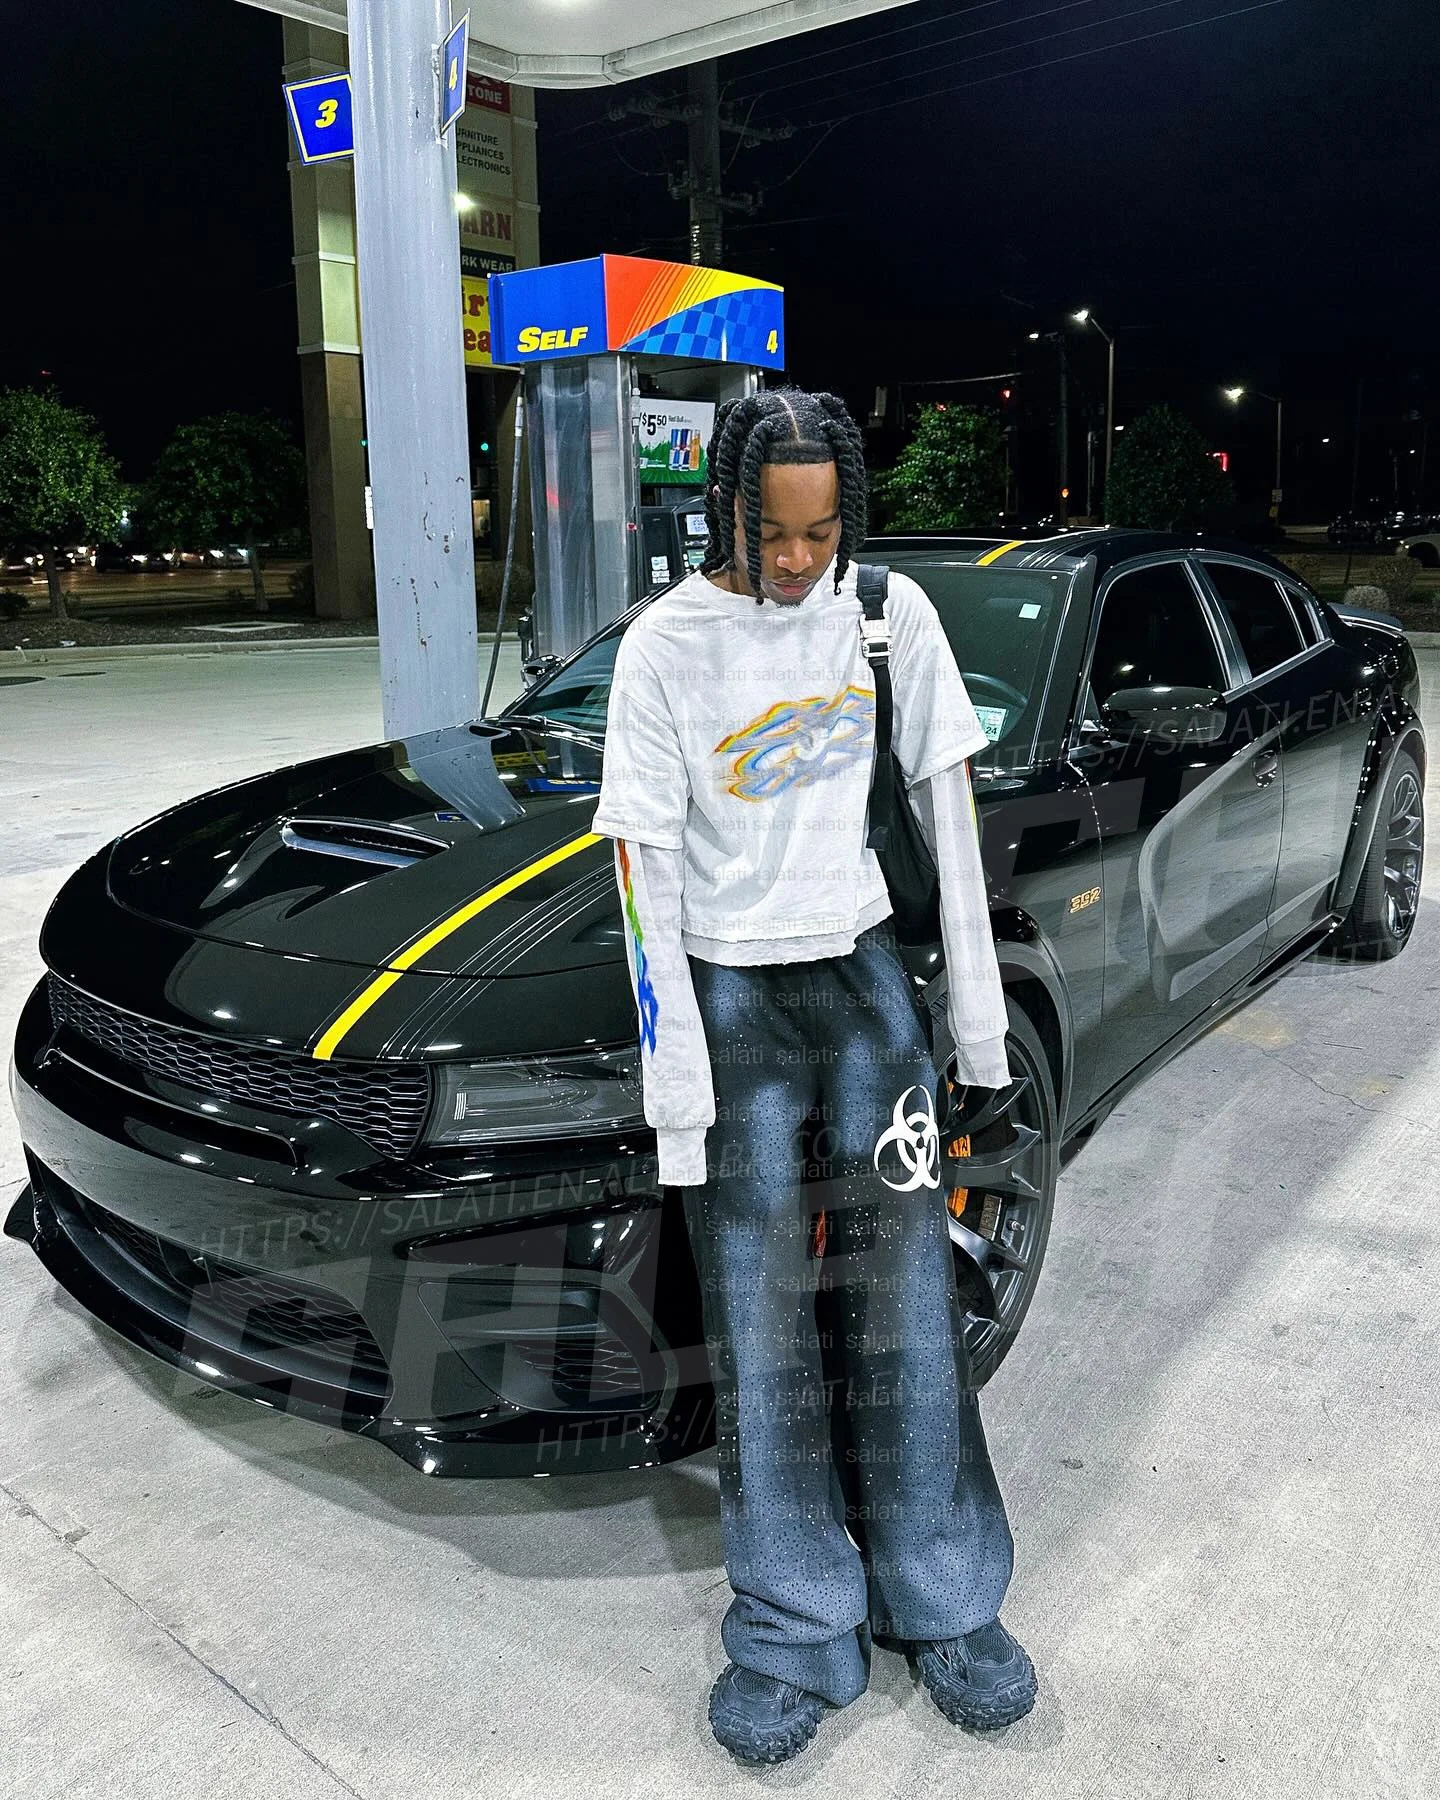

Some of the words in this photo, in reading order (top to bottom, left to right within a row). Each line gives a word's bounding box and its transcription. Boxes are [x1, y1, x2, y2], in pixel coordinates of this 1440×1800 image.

[448, 56, 458, 91] 4
[466, 83, 503, 104] TONE
[315, 99, 338, 129] 3
[457, 128, 500, 146] URNITURE
[456, 140, 504, 160] PPLIANCES
[457, 153, 511, 176] LECTRONICS
[462, 209, 512, 241] ARN
[461, 255, 478, 269] RK
[479, 259, 513, 273] WEAR
[463, 327, 491, 353] ea
[517, 326, 589, 354] SELF
[766, 329, 778, 354] 4
[985, 726, 997, 735] 24
[1069, 886, 1102, 914] 392
